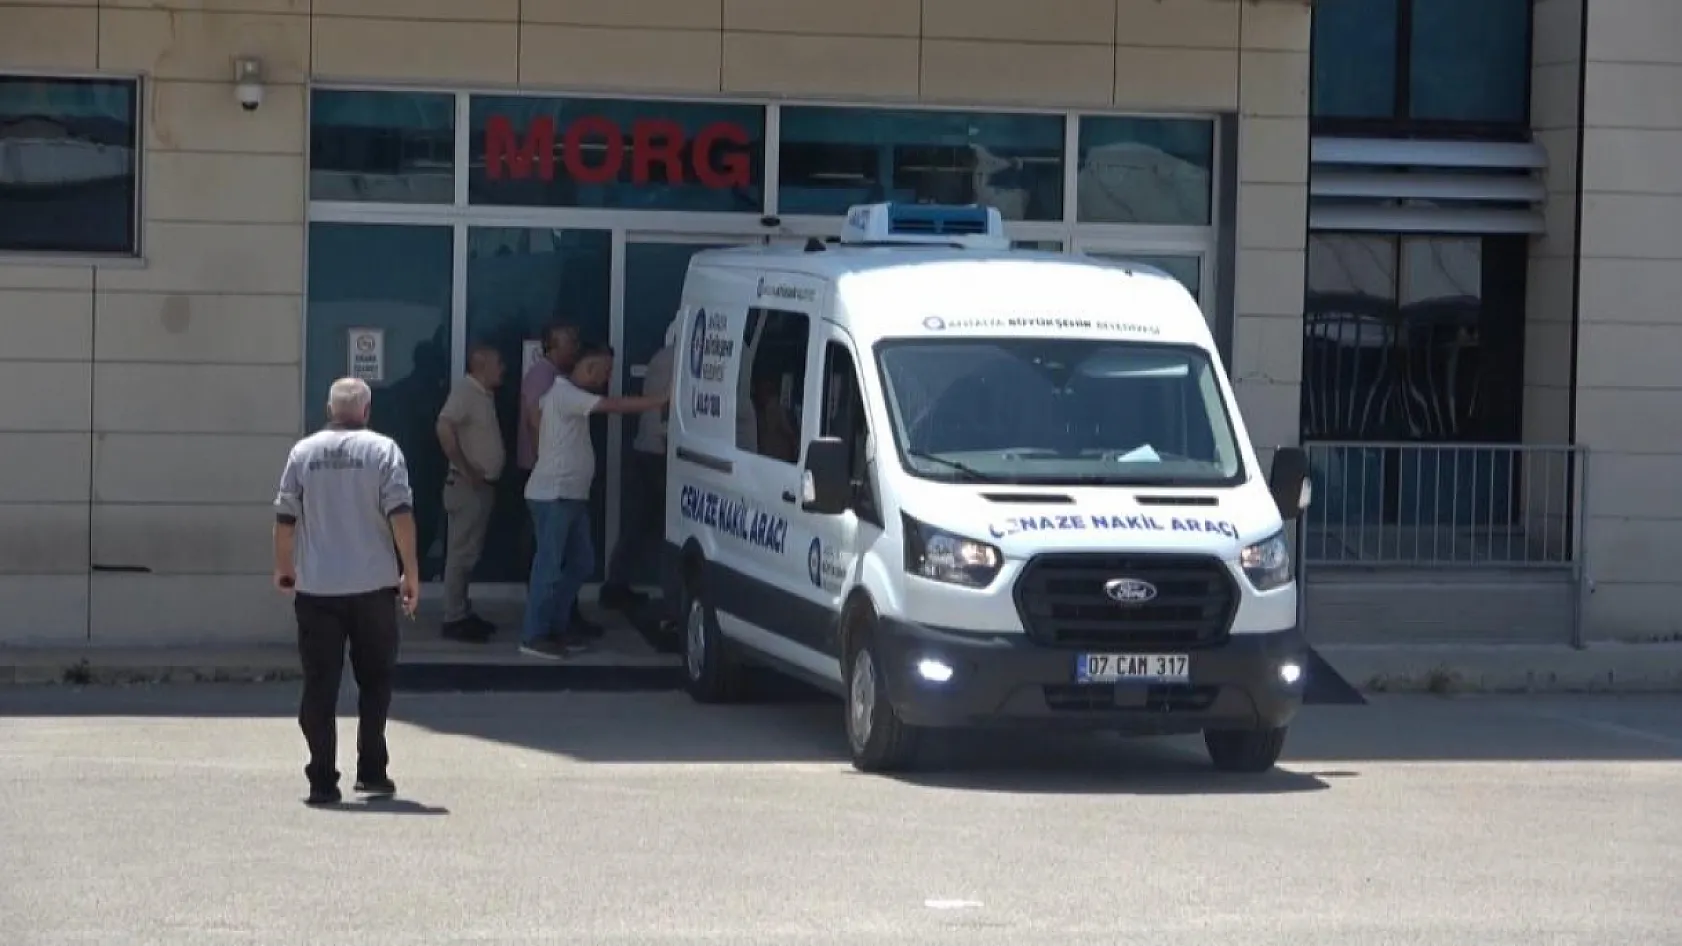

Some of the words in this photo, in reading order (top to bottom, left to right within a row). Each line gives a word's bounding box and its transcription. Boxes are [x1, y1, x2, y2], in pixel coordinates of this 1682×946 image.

[485, 115, 751, 189] MORG
[681, 484, 719, 528] CENAZE
[719, 496, 748, 540] NAKİL
[750, 511, 788, 554] ARACI
[1091, 512, 1164, 531] NAKİL
[1171, 516, 1240, 540] ARACI
[1090, 657, 1108, 675] 07
[1157, 657, 1187, 675] 317
